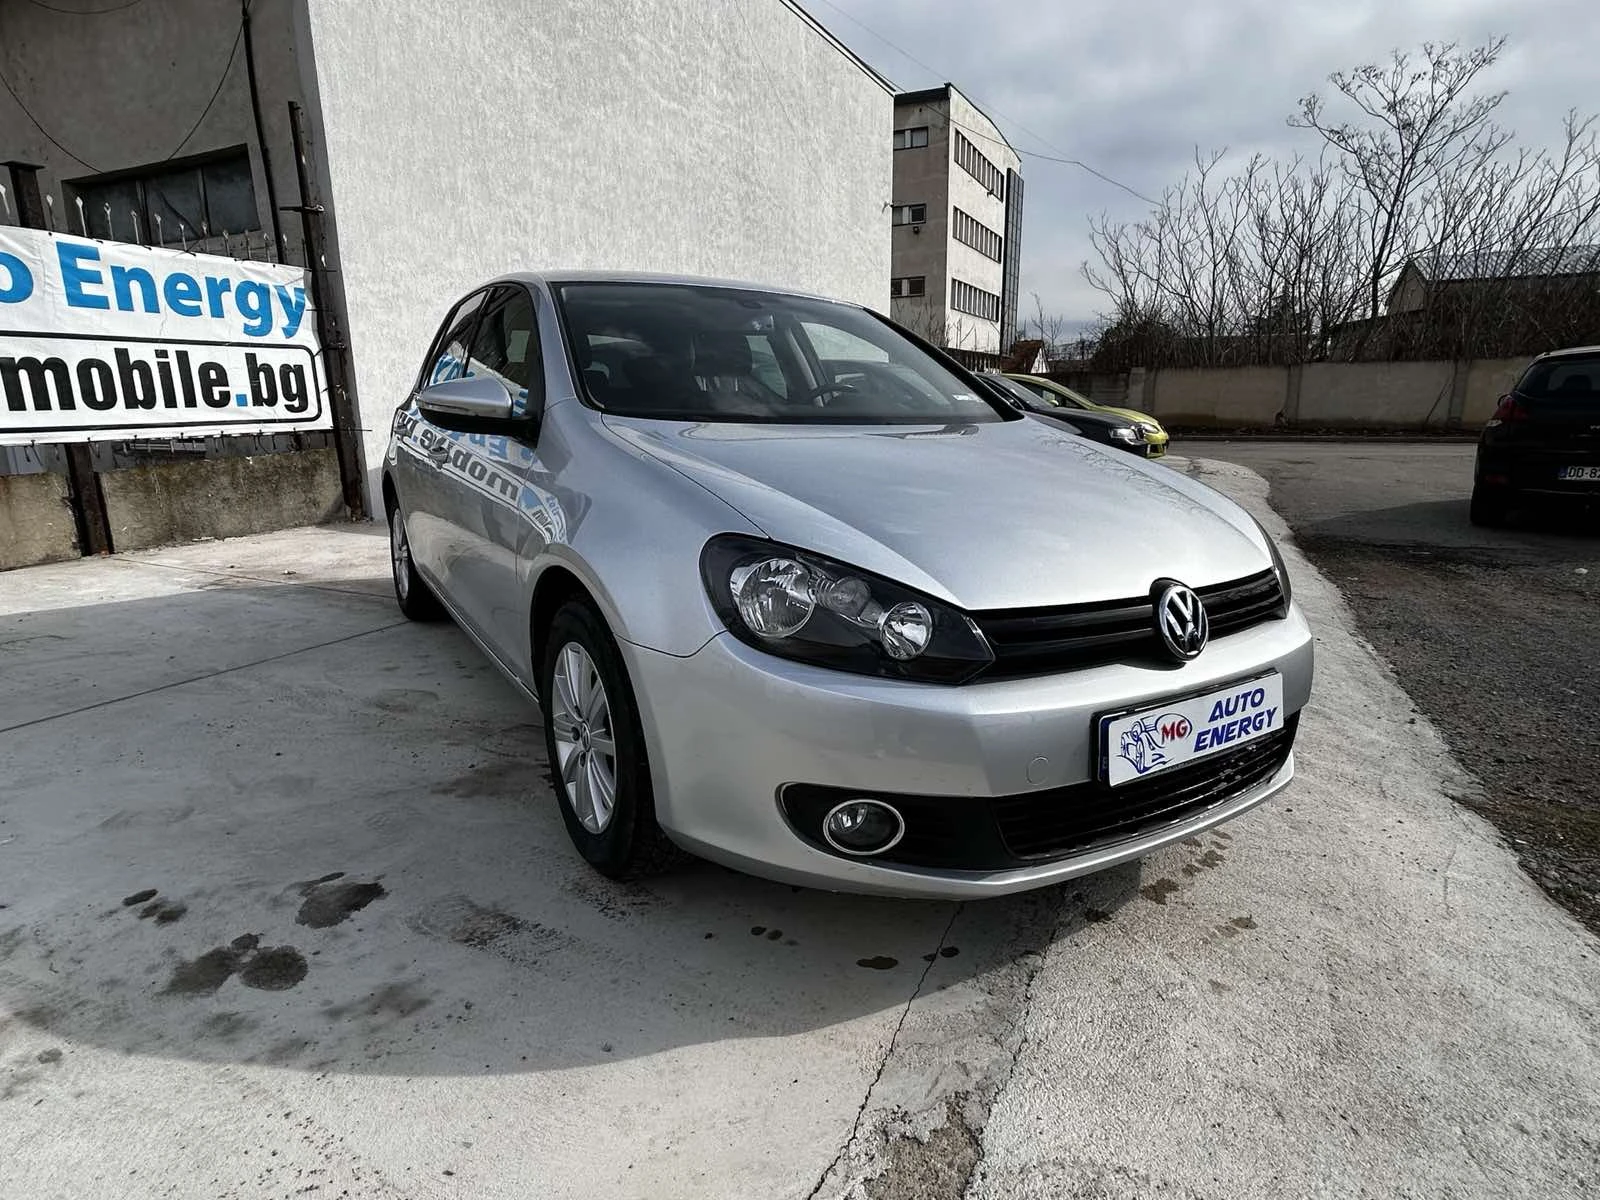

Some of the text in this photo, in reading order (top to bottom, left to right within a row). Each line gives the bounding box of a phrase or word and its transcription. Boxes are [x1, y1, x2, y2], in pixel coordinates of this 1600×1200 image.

[56, 241, 306, 339] Energy
[1, 347, 309, 413] mobile.bg
[1208, 688, 1265, 723] AUTO
[1161, 719, 1188, 745] MG
[1193, 706, 1279, 753] ENERGY
